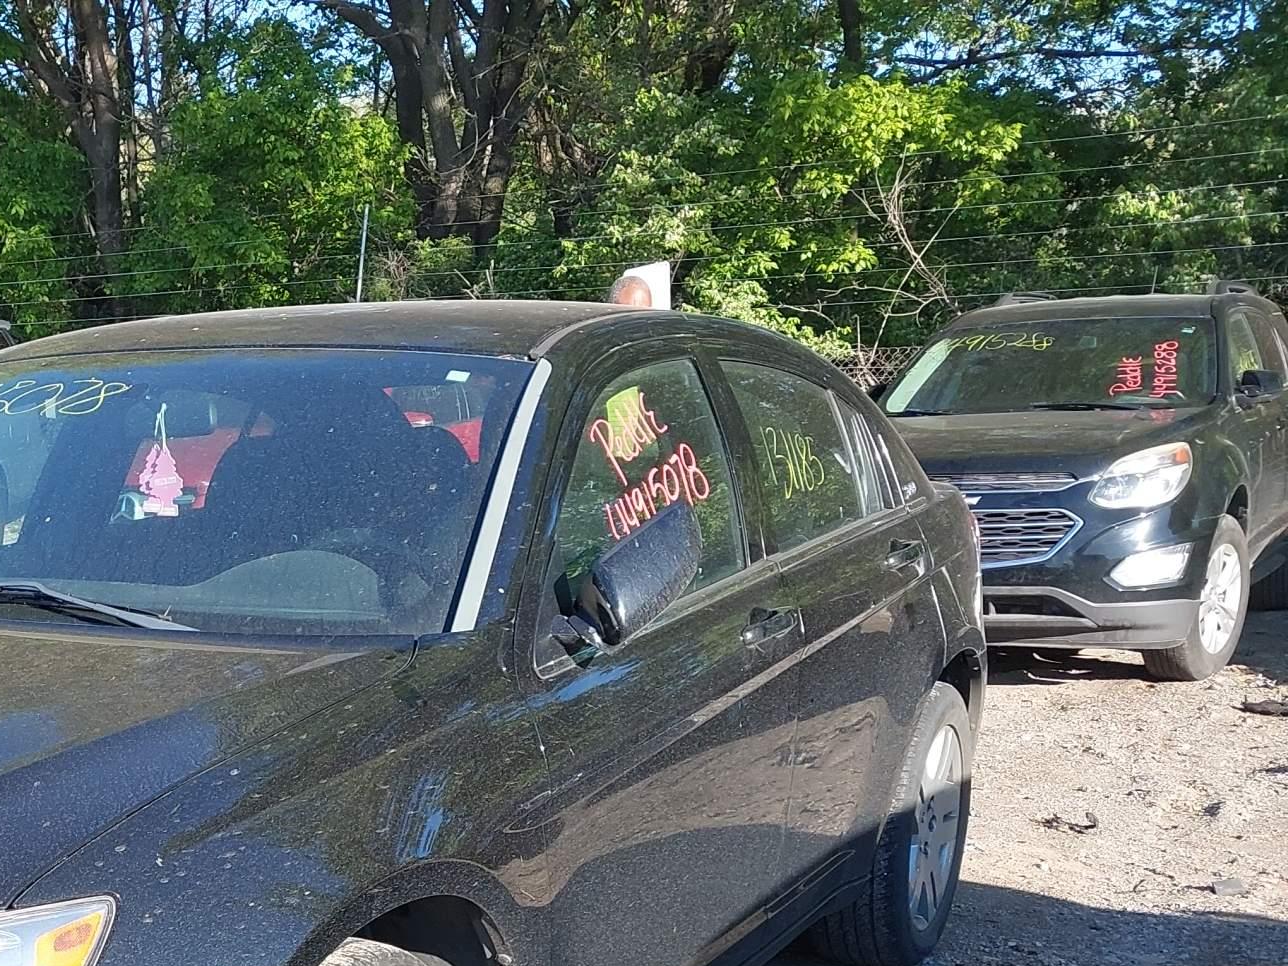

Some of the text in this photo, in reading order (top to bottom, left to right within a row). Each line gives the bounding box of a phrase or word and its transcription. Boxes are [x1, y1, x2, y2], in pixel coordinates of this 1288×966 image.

[1109, 355, 1142, 396] Peddle
[1149, 340, 1179, 398] 44915288
[605, 442, 710, 541] 44915078
